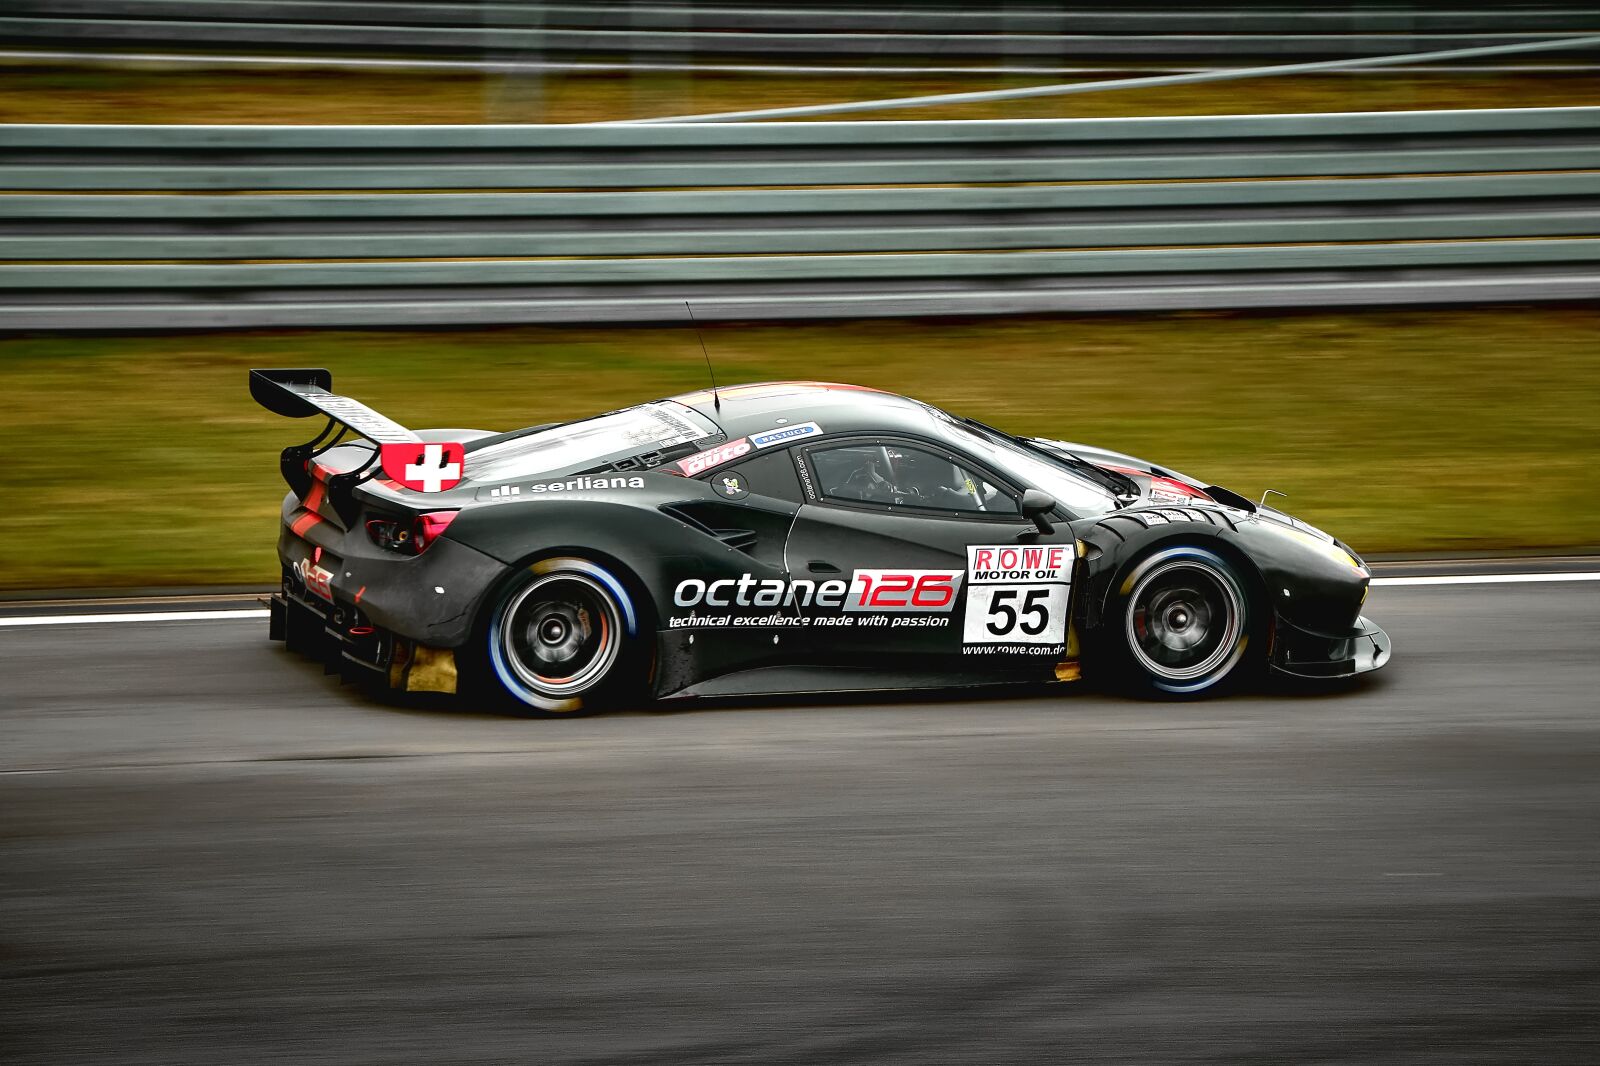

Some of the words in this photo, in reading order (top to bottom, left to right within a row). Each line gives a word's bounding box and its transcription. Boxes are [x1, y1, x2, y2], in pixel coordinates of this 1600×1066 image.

[531, 476, 645, 493] serliana
[974, 548, 1064, 570] ROWE
[974, 570, 1030, 580] MOTOR
[1035, 570, 1058, 579] OIL
[669, 614, 732, 628] technical
[733, 614, 810, 626] excellence
[813, 615, 853, 626] made
[857, 615, 888, 626] with
[891, 616, 949, 628] passion
[986, 589, 1050, 636] 55
